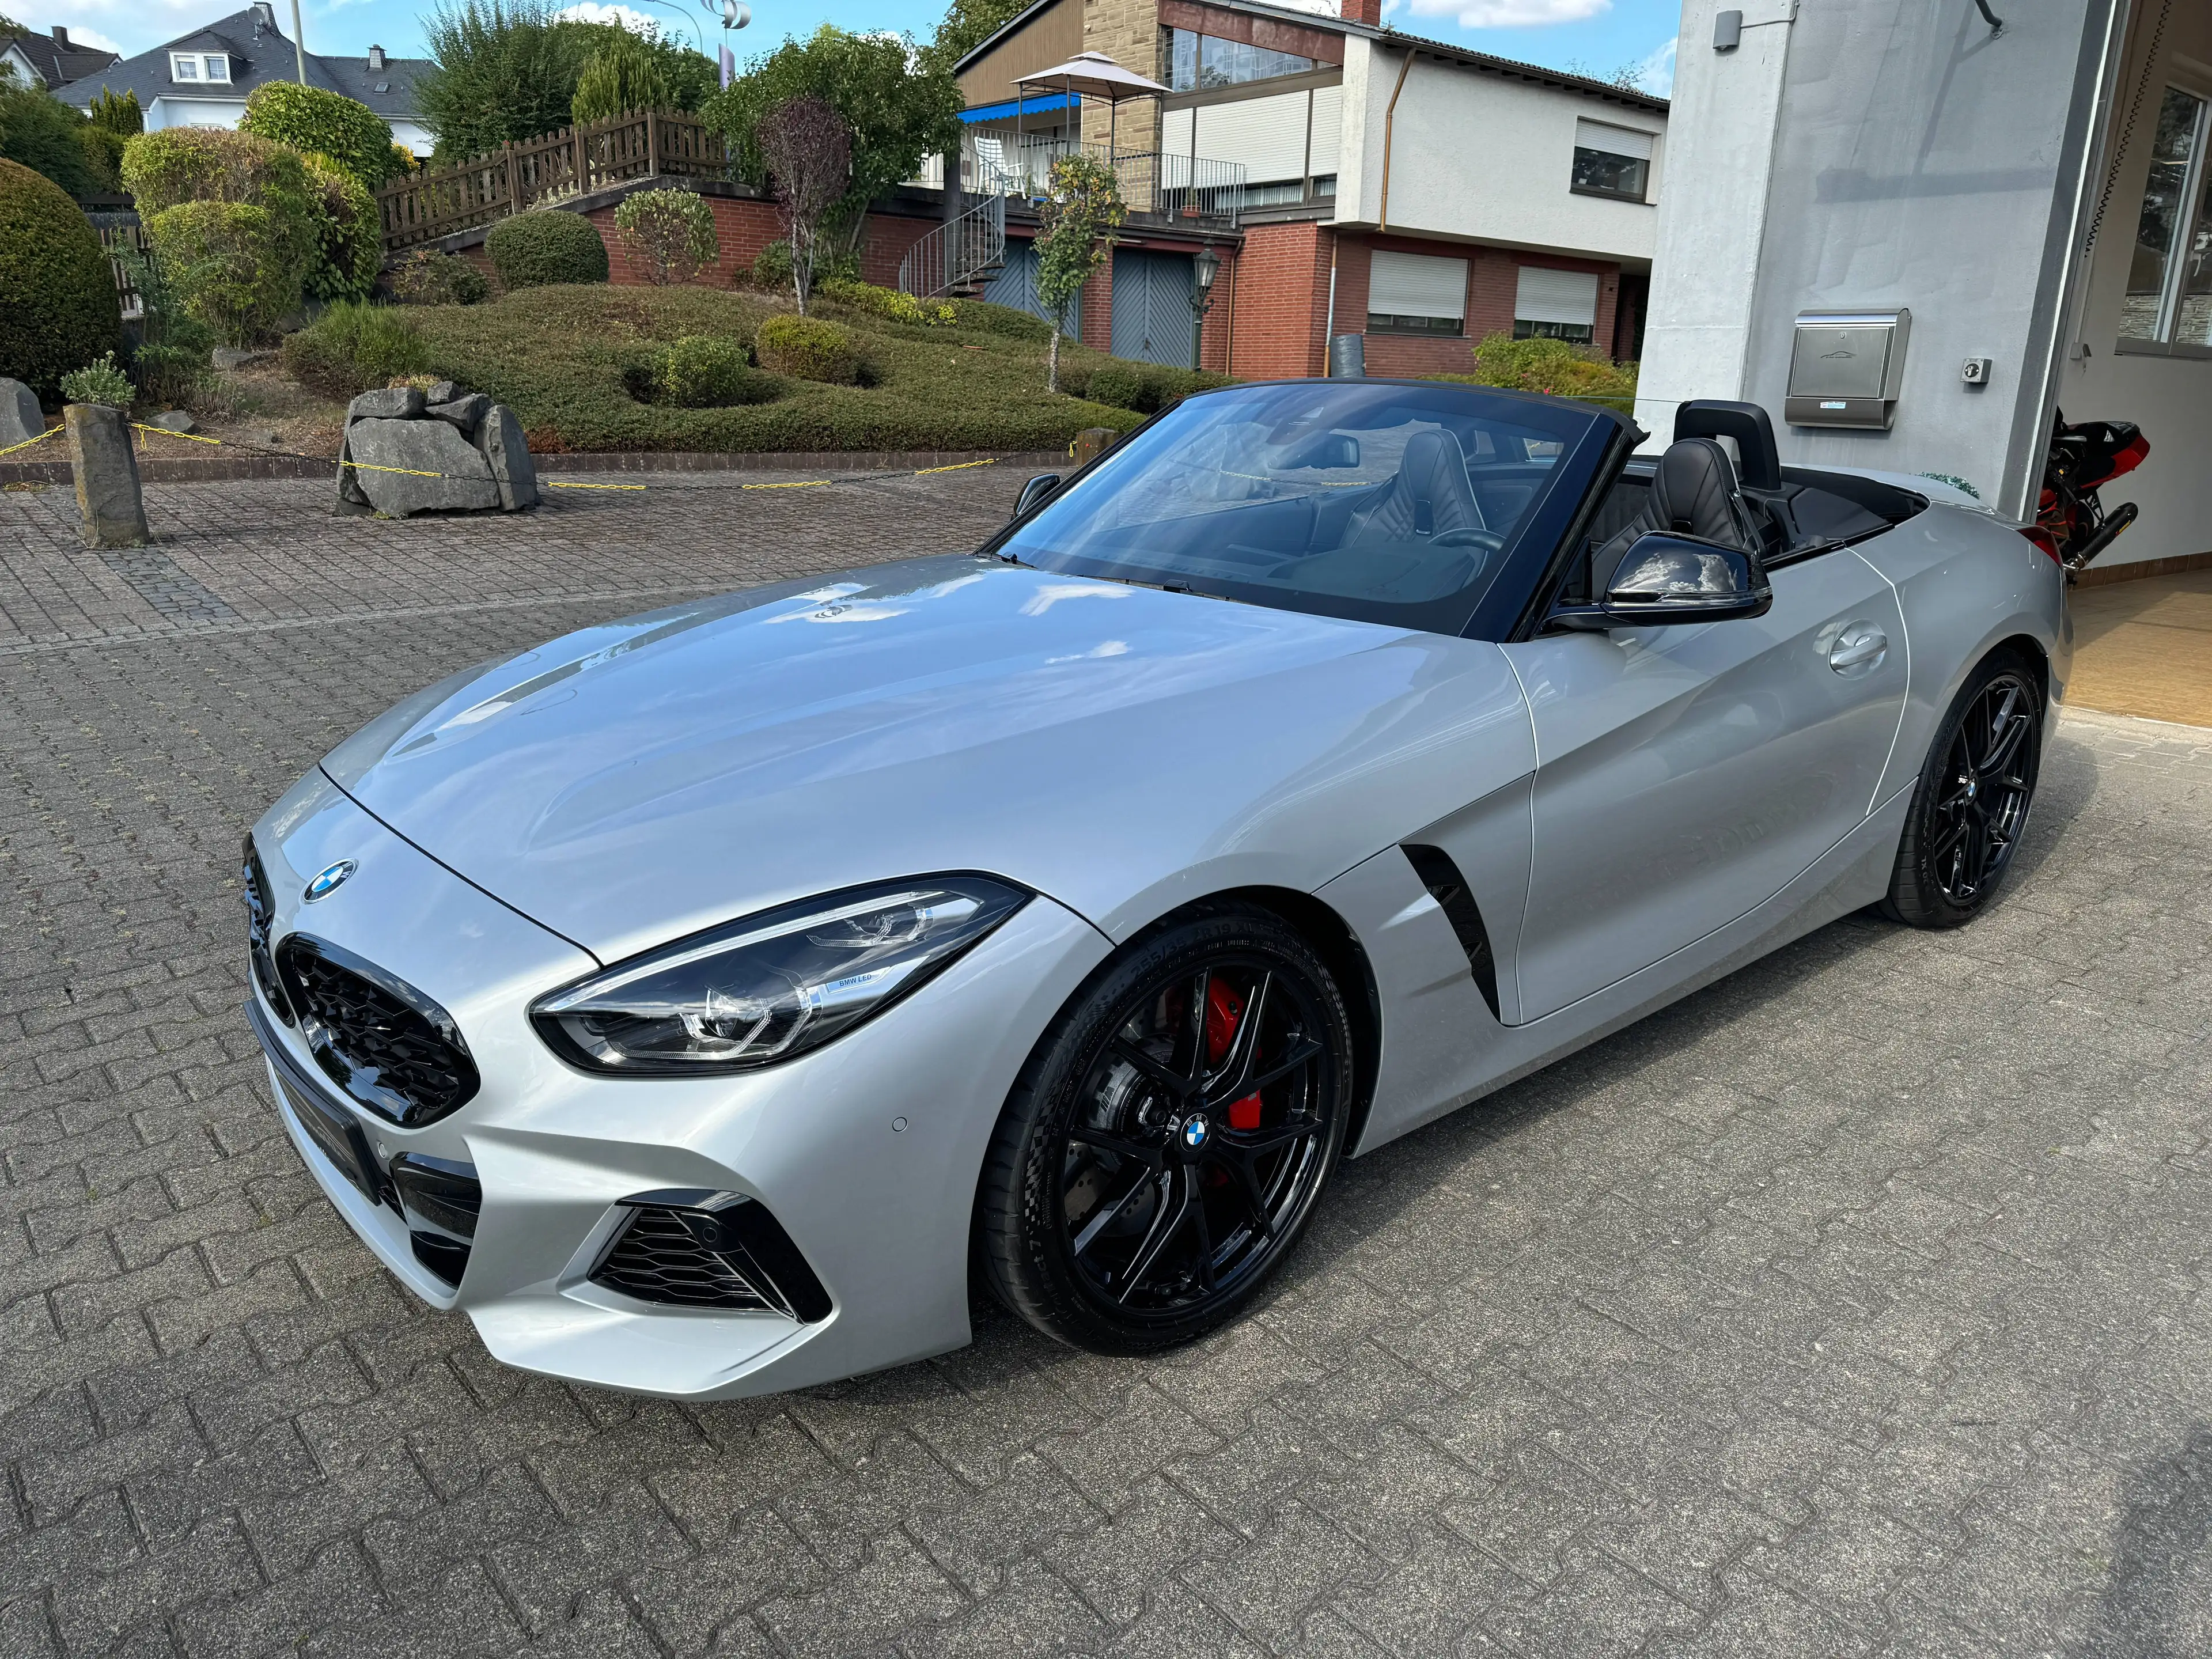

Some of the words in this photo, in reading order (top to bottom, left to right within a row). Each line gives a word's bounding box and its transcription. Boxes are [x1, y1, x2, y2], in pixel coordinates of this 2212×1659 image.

[1215, 923, 1232, 935] 19
[839, 978, 856, 986] BMW
[1186, 1114, 1209, 1127] BMW
